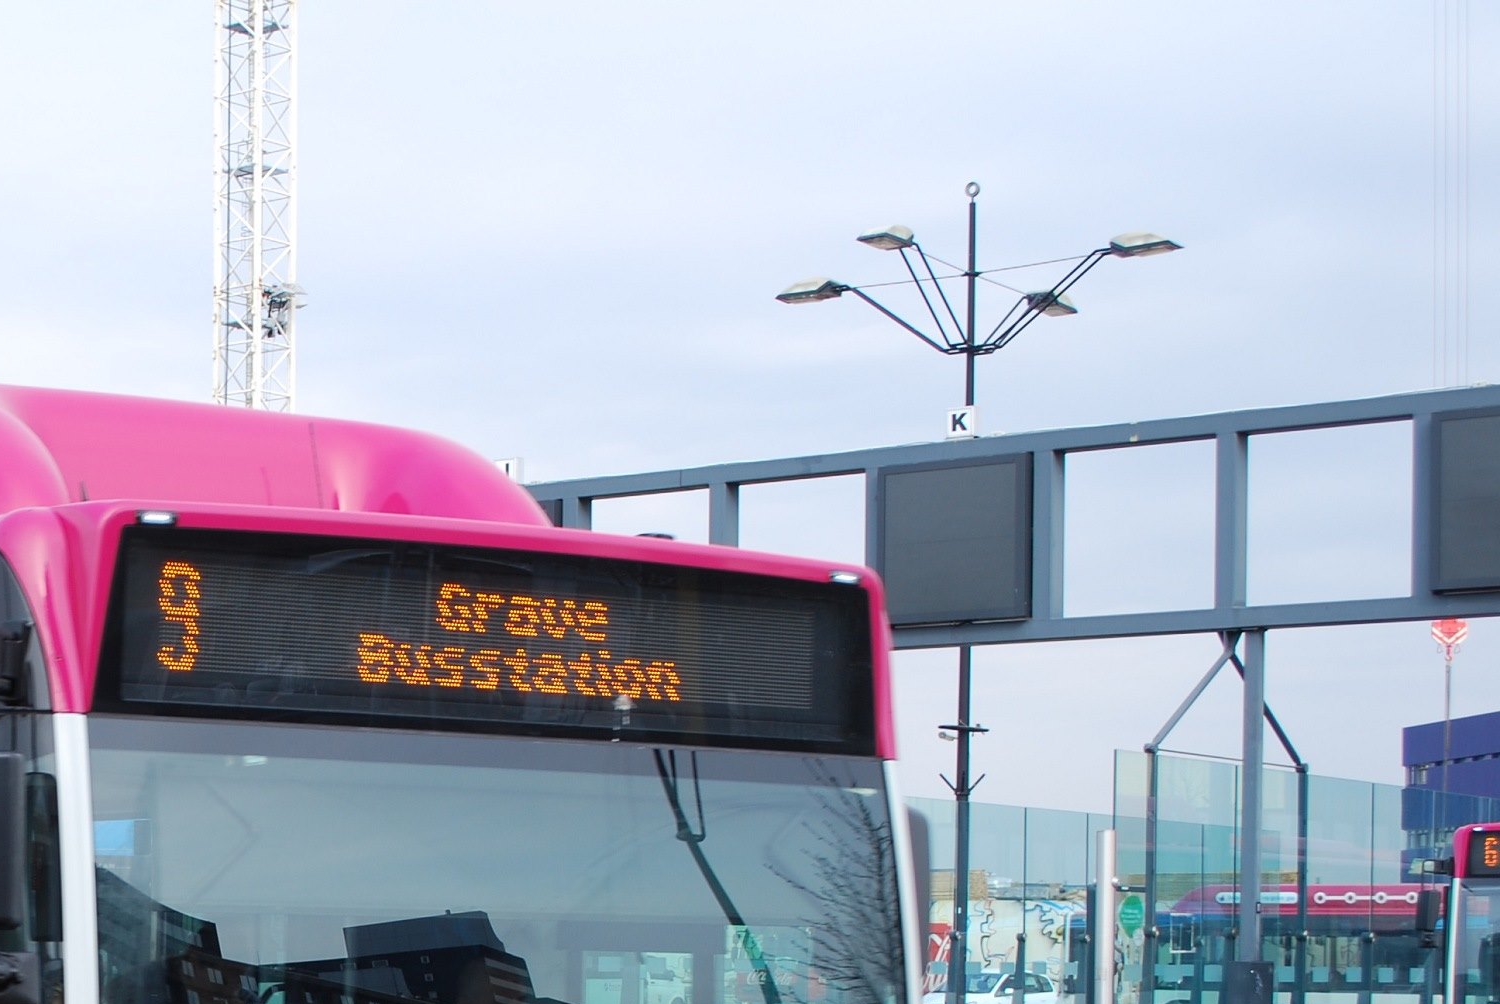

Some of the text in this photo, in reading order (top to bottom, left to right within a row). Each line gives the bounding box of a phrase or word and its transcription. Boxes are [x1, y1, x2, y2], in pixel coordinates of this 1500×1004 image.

[952, 412, 968, 432] K
[157, 560, 202, 672] 9
[435, 582, 610, 642] Grave
[357, 632, 681, 703] Busstation
